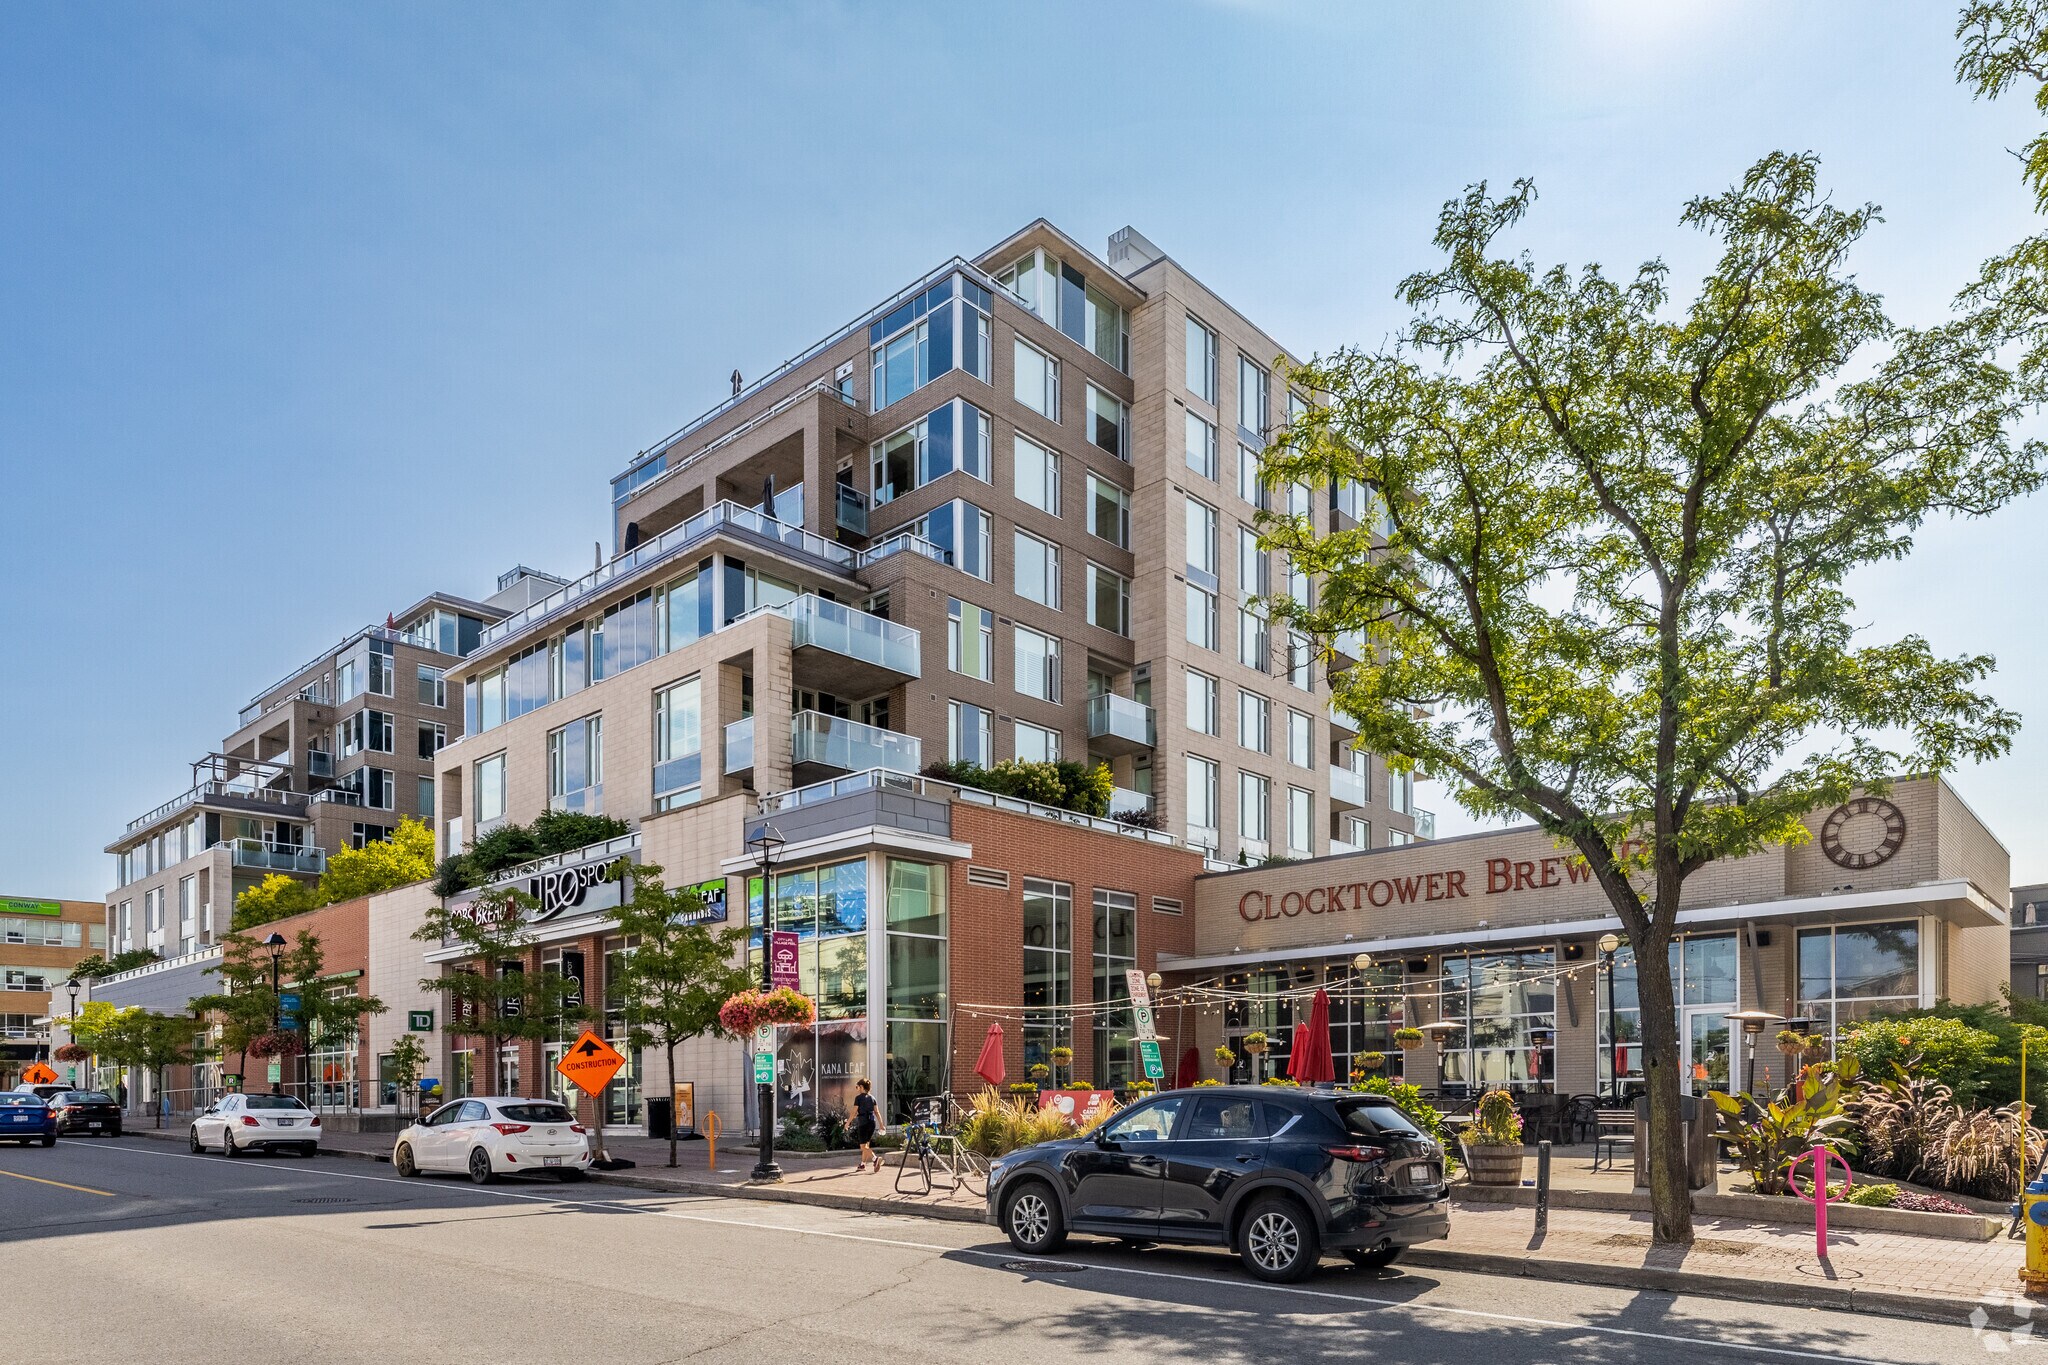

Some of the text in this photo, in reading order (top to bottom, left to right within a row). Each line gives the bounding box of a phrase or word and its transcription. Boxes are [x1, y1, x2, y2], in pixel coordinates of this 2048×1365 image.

[1238, 869, 1469, 922] CLOCKTOWER
[8, 901, 39, 909] CONWAY
[680, 908, 712, 923] CANNABIS
[412, 1014, 431, 1027] TD
[566, 1058, 617, 1071] CONSTRUCTION
[821, 1061, 866, 1075] KANA LEAF
